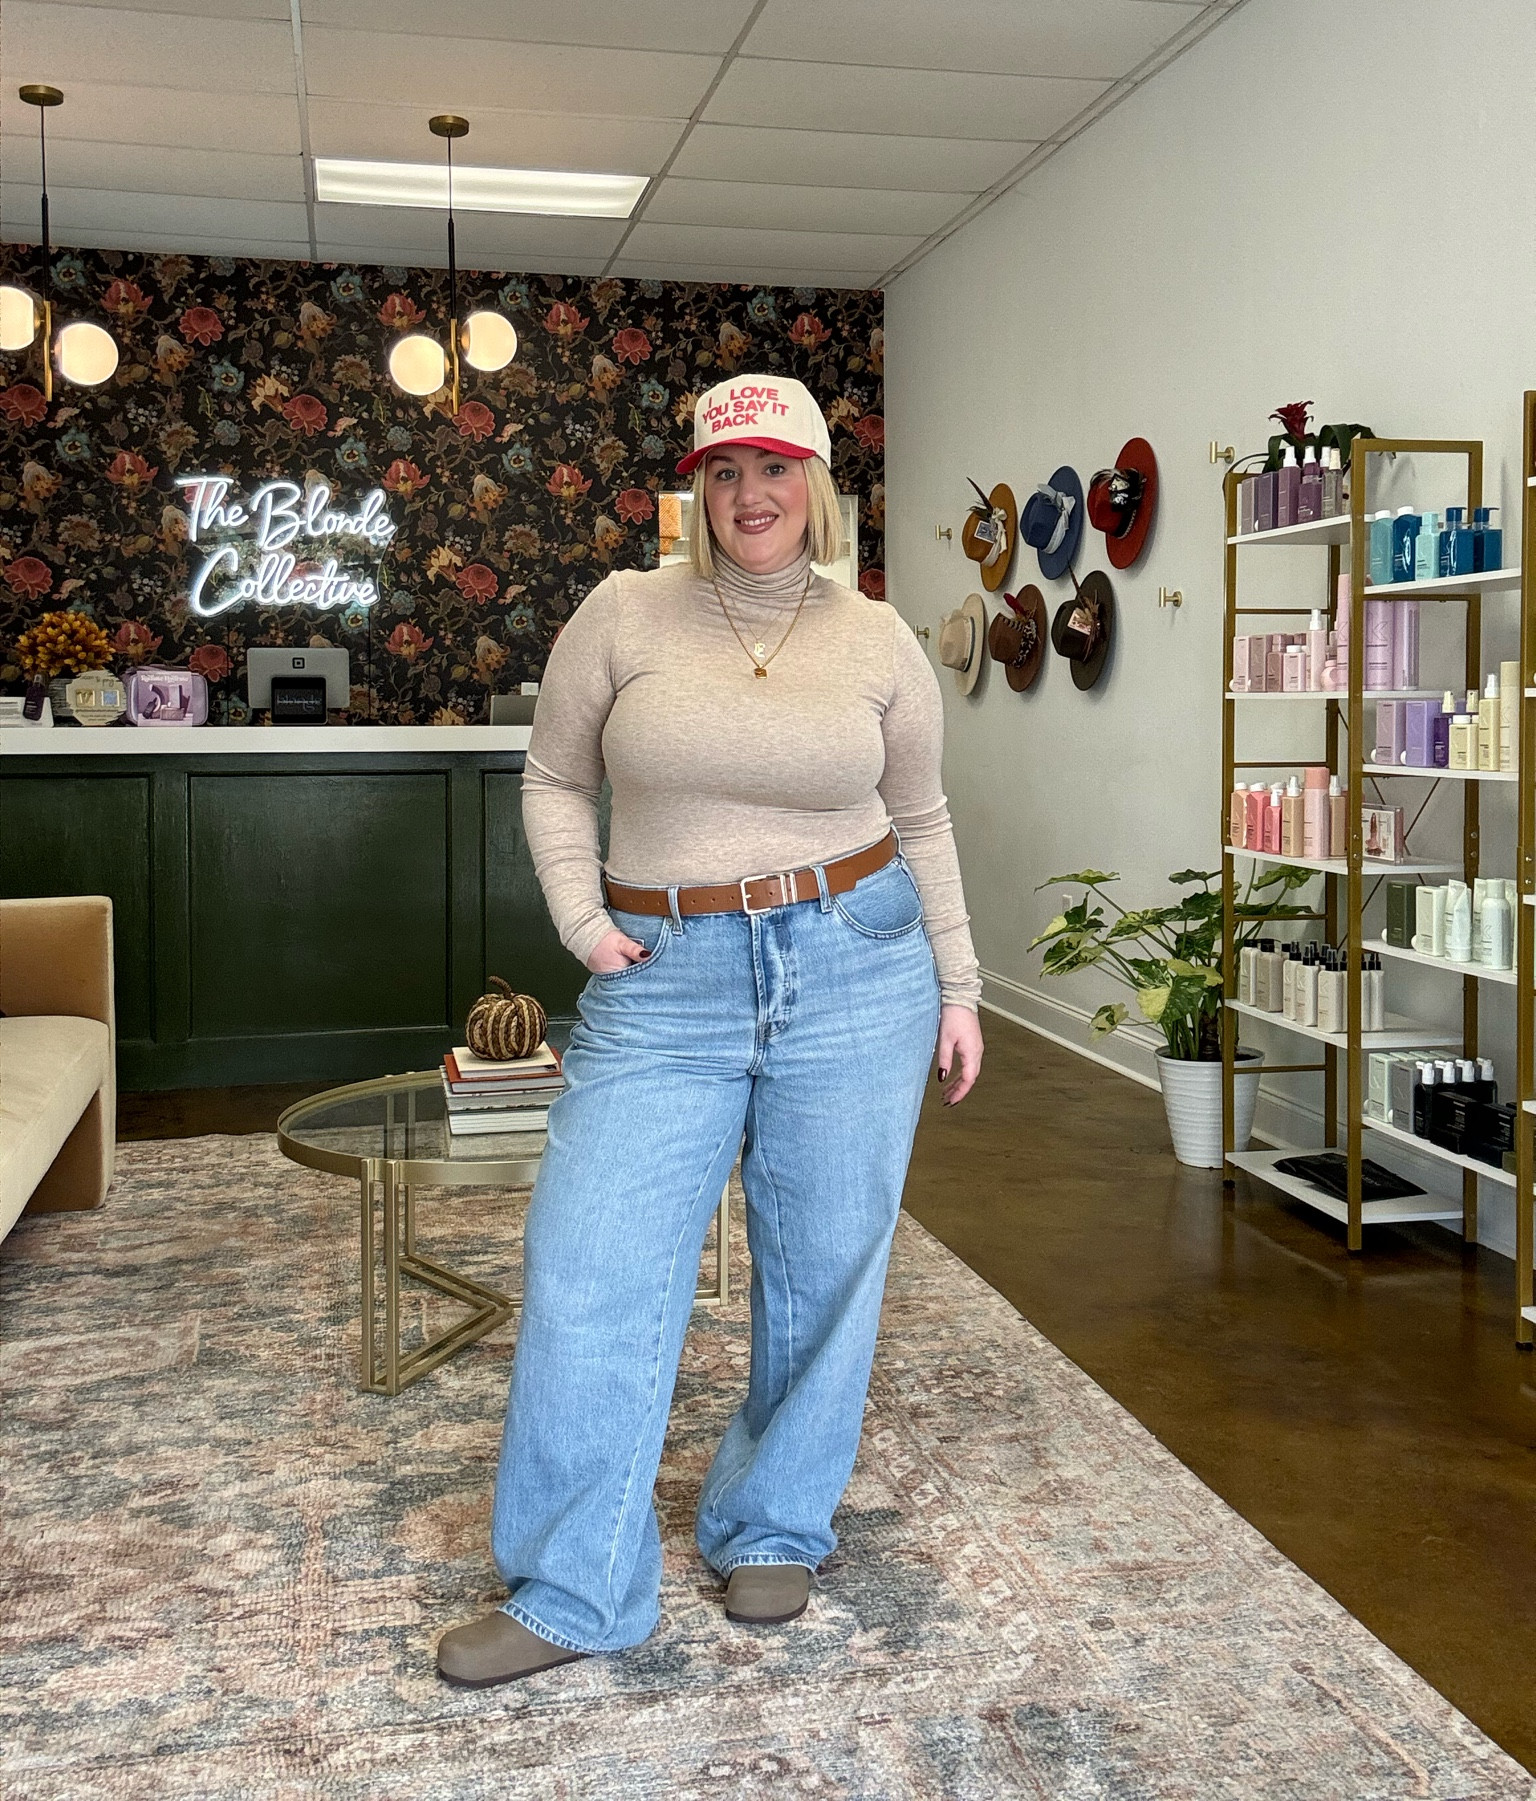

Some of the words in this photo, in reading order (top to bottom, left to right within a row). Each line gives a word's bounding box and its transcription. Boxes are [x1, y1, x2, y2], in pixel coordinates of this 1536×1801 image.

[708, 396, 713, 408] I
[730, 386, 779, 401] LOVE
[702, 403, 729, 424] YOU
[733, 400, 769, 413] SAY
[772, 402, 789, 416] IT
[711, 413, 759, 434] BACK
[174, 475, 249, 543] The
[252, 481, 396, 551] Blonde
[191, 546, 379, 617] Collective
